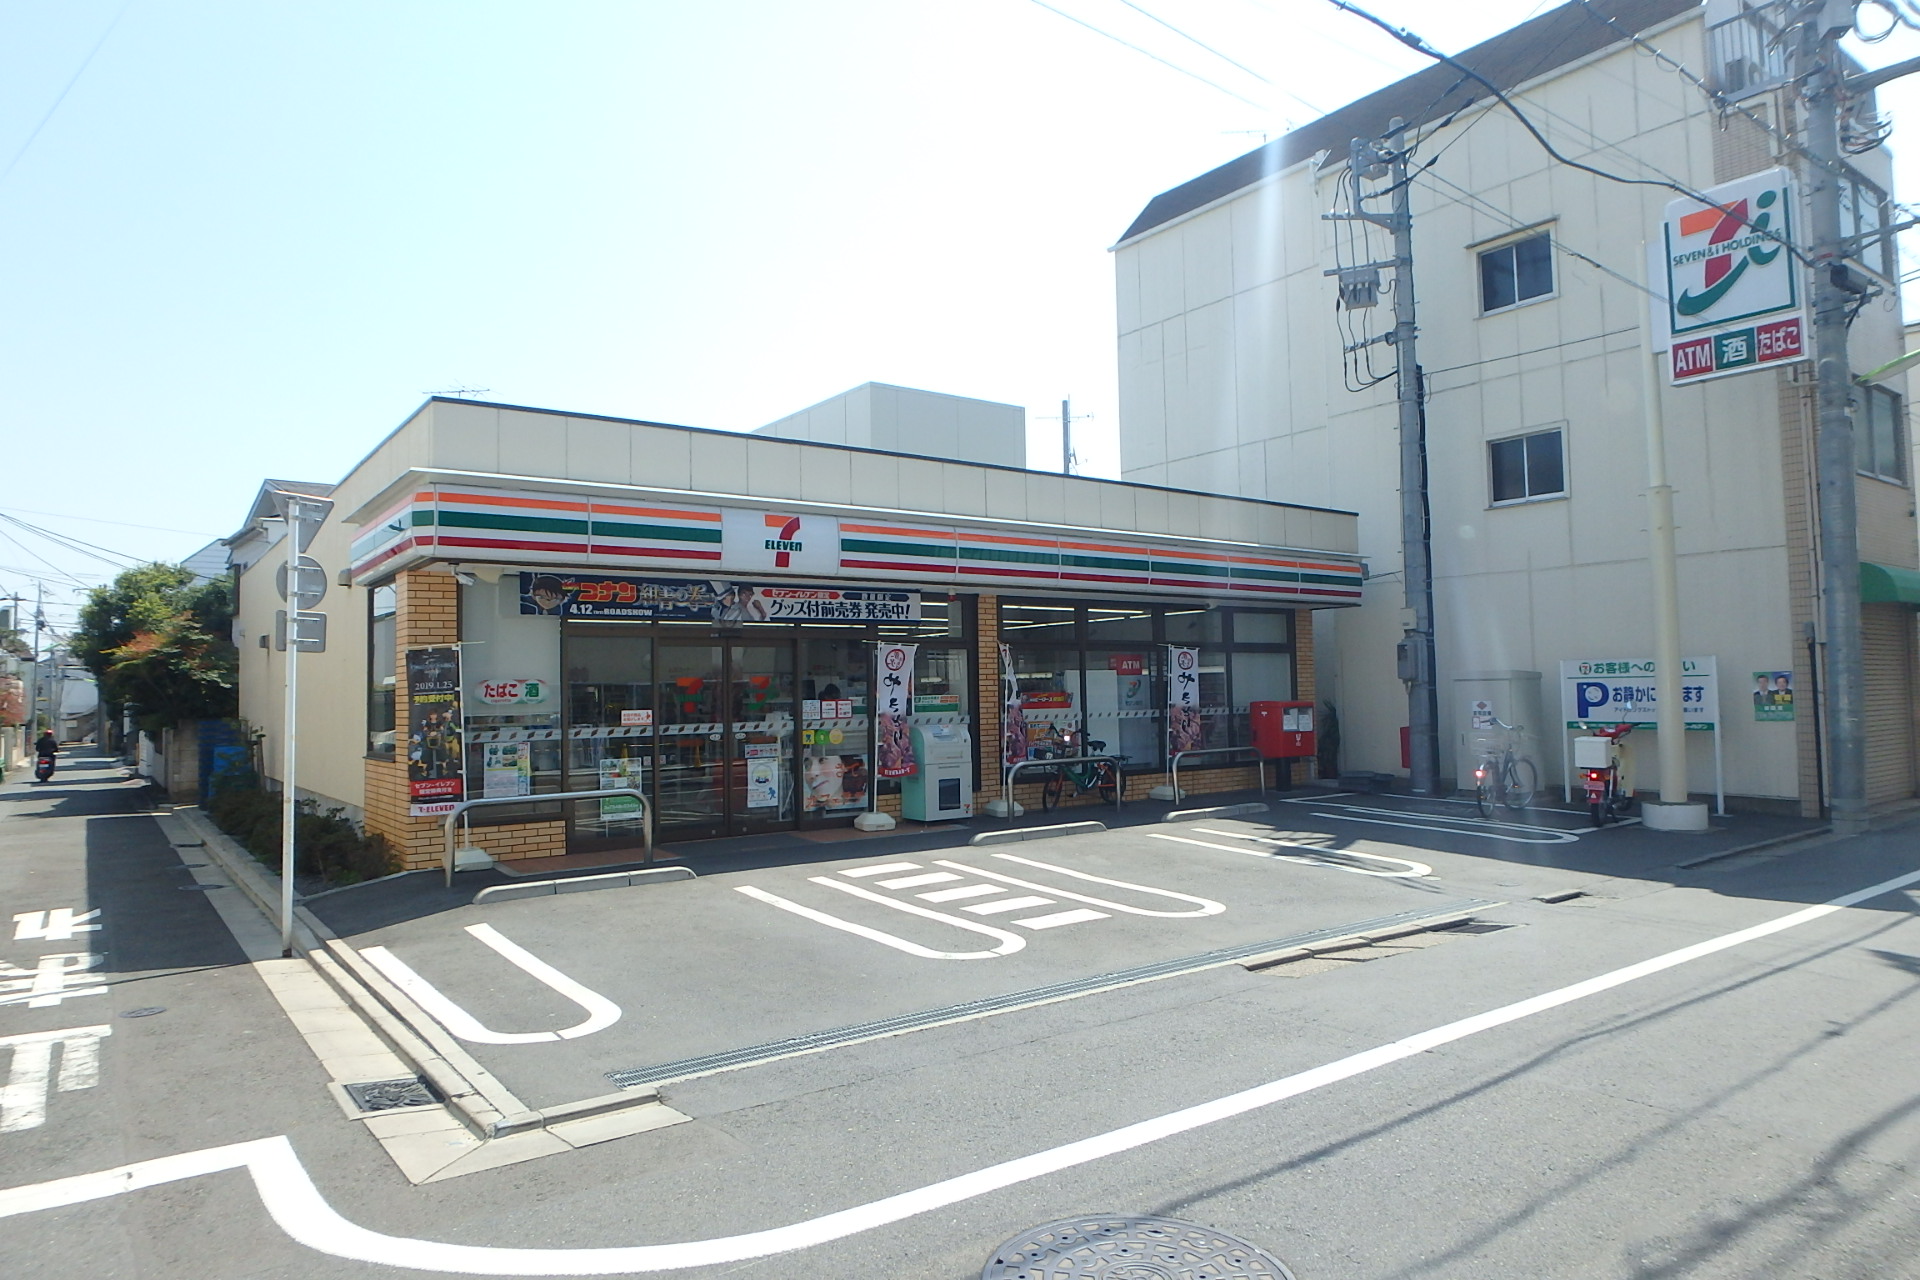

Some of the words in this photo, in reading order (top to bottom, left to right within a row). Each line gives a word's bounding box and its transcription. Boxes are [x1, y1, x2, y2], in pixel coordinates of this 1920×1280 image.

[1721, 334, 1748, 364] 酒
[1759, 326, 1800, 356] たばこ
[1675, 342, 1711, 374] ATM
[578, 581, 637, 602] コナン
[569, 603, 593, 615] 4.12
[603, 608, 653, 616] ROADSHOW
[771, 600, 863, 618] グッズ付前売券
[1121, 660, 1140, 670] ATM
[415, 681, 453, 691] 2019.1.25
[484, 683, 519, 698] たばこ
[525, 683, 540, 698] 酒
[1576, 682, 1609, 719] P
